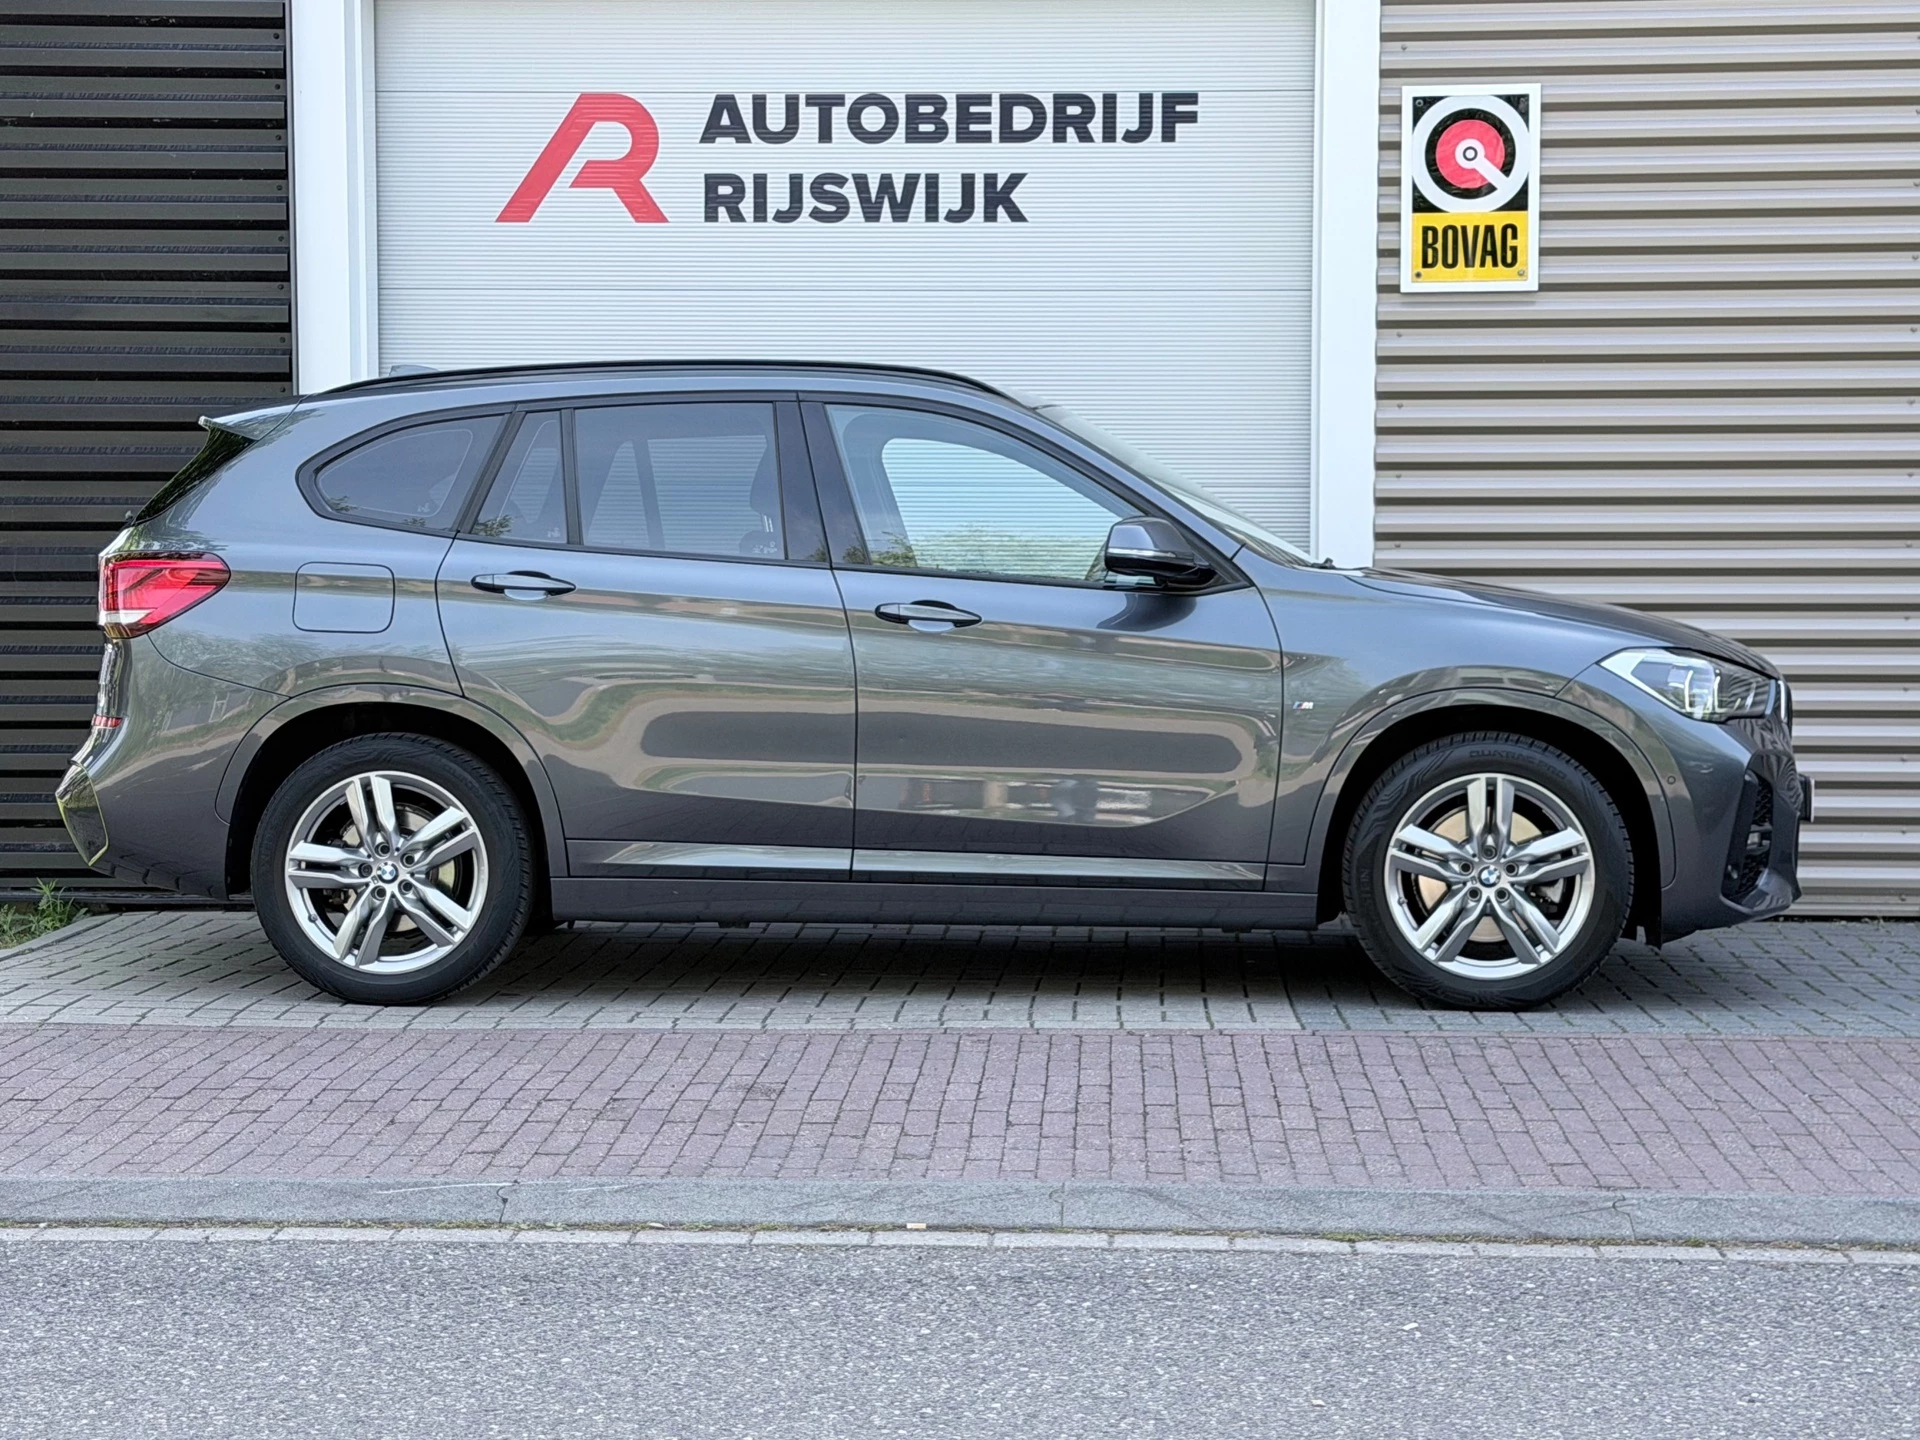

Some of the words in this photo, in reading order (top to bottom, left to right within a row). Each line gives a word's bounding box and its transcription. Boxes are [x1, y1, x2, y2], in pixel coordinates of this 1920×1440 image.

[699, 92, 1199, 144] AUTOBEDRIJF
[703, 172, 1029, 223] RIJSWIJK
[1421, 223, 1519, 269] BOVAG
